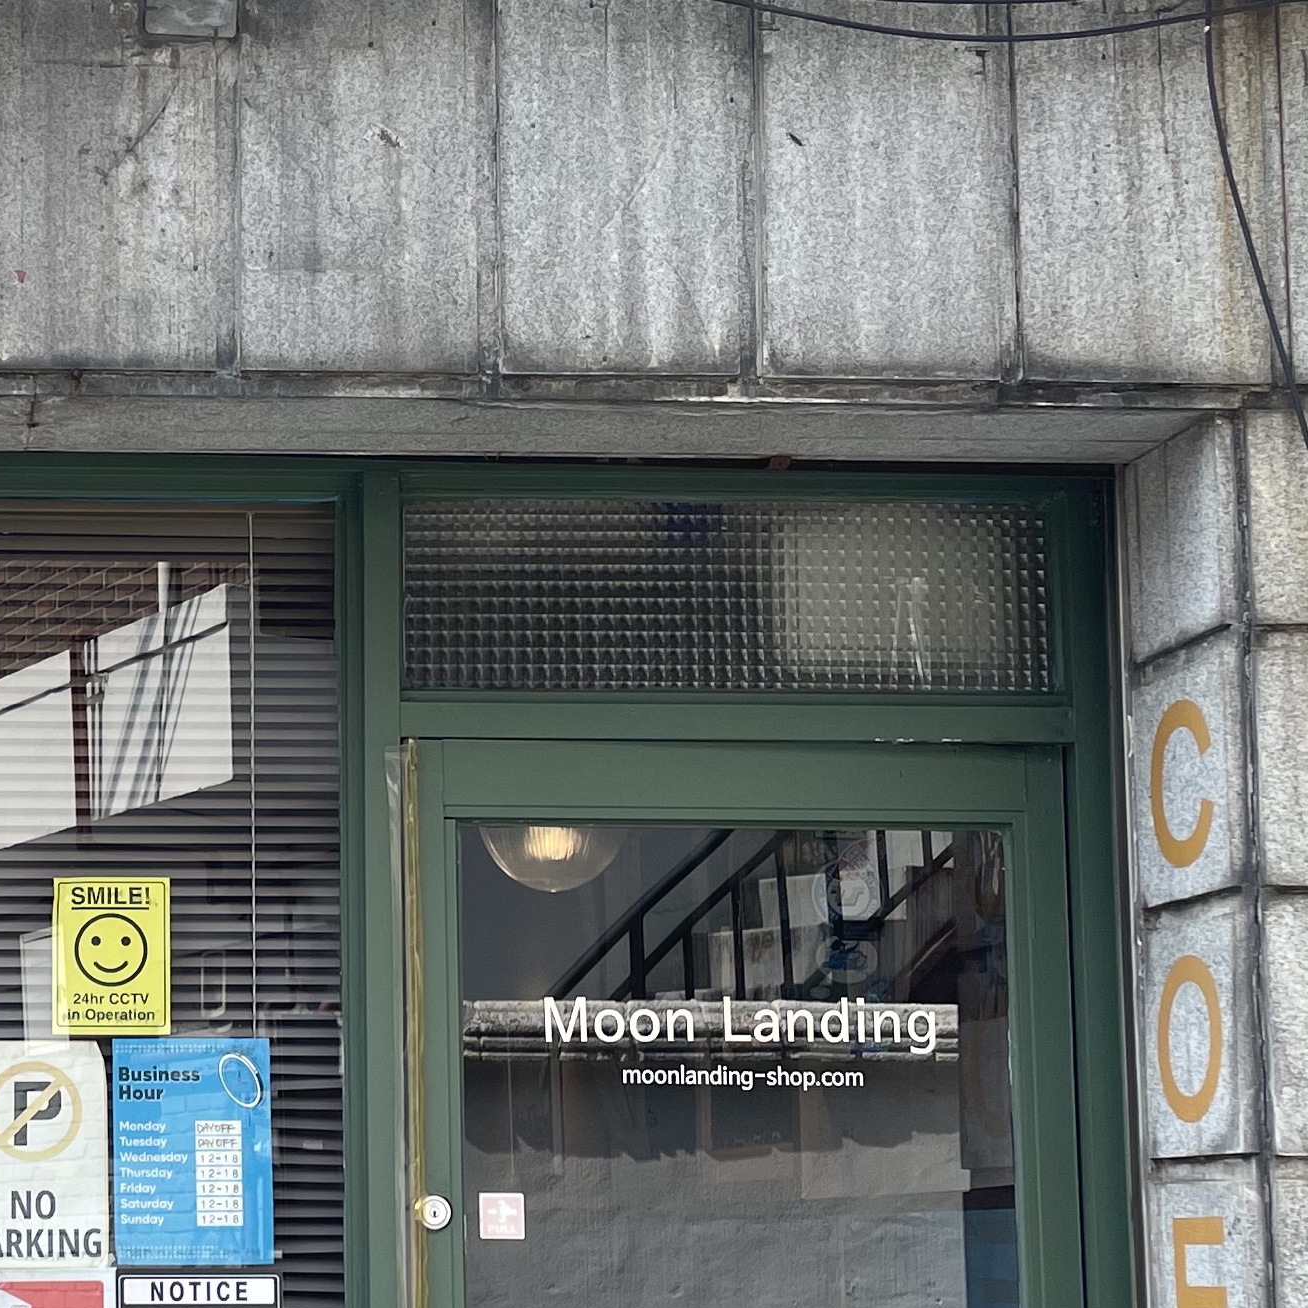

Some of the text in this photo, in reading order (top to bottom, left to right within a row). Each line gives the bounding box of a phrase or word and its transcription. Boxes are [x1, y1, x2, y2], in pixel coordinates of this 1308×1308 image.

[71, 887, 150, 905] SMILE!
[73, 993, 150, 1005] 24hr CCTV
[67, 1009, 155, 1025] in Operation
[543, 996, 936, 1053] Moon Landing
[118, 1066, 200, 1082] Business
[622, 1064, 865, 1090] moonlanding-shop.com
[118, 1084, 164, 1101] Hour
[119, 1121, 167, 1133] Monday
[119, 1137, 167, 1149] Tuesday
[120, 1152, 188, 1164] Wednesday
[120, 1168, 173, 1179] Thursday
[120, 1183, 156, 1195] Friday
[11, 1190, 56, 1220] NO
[120, 1199, 174, 1211] Saturday
[120, 1214, 164, 1226] Sunday
[488, 1224, 517, 1234] PULL
[150, 1281, 248, 1301] NOTICE
